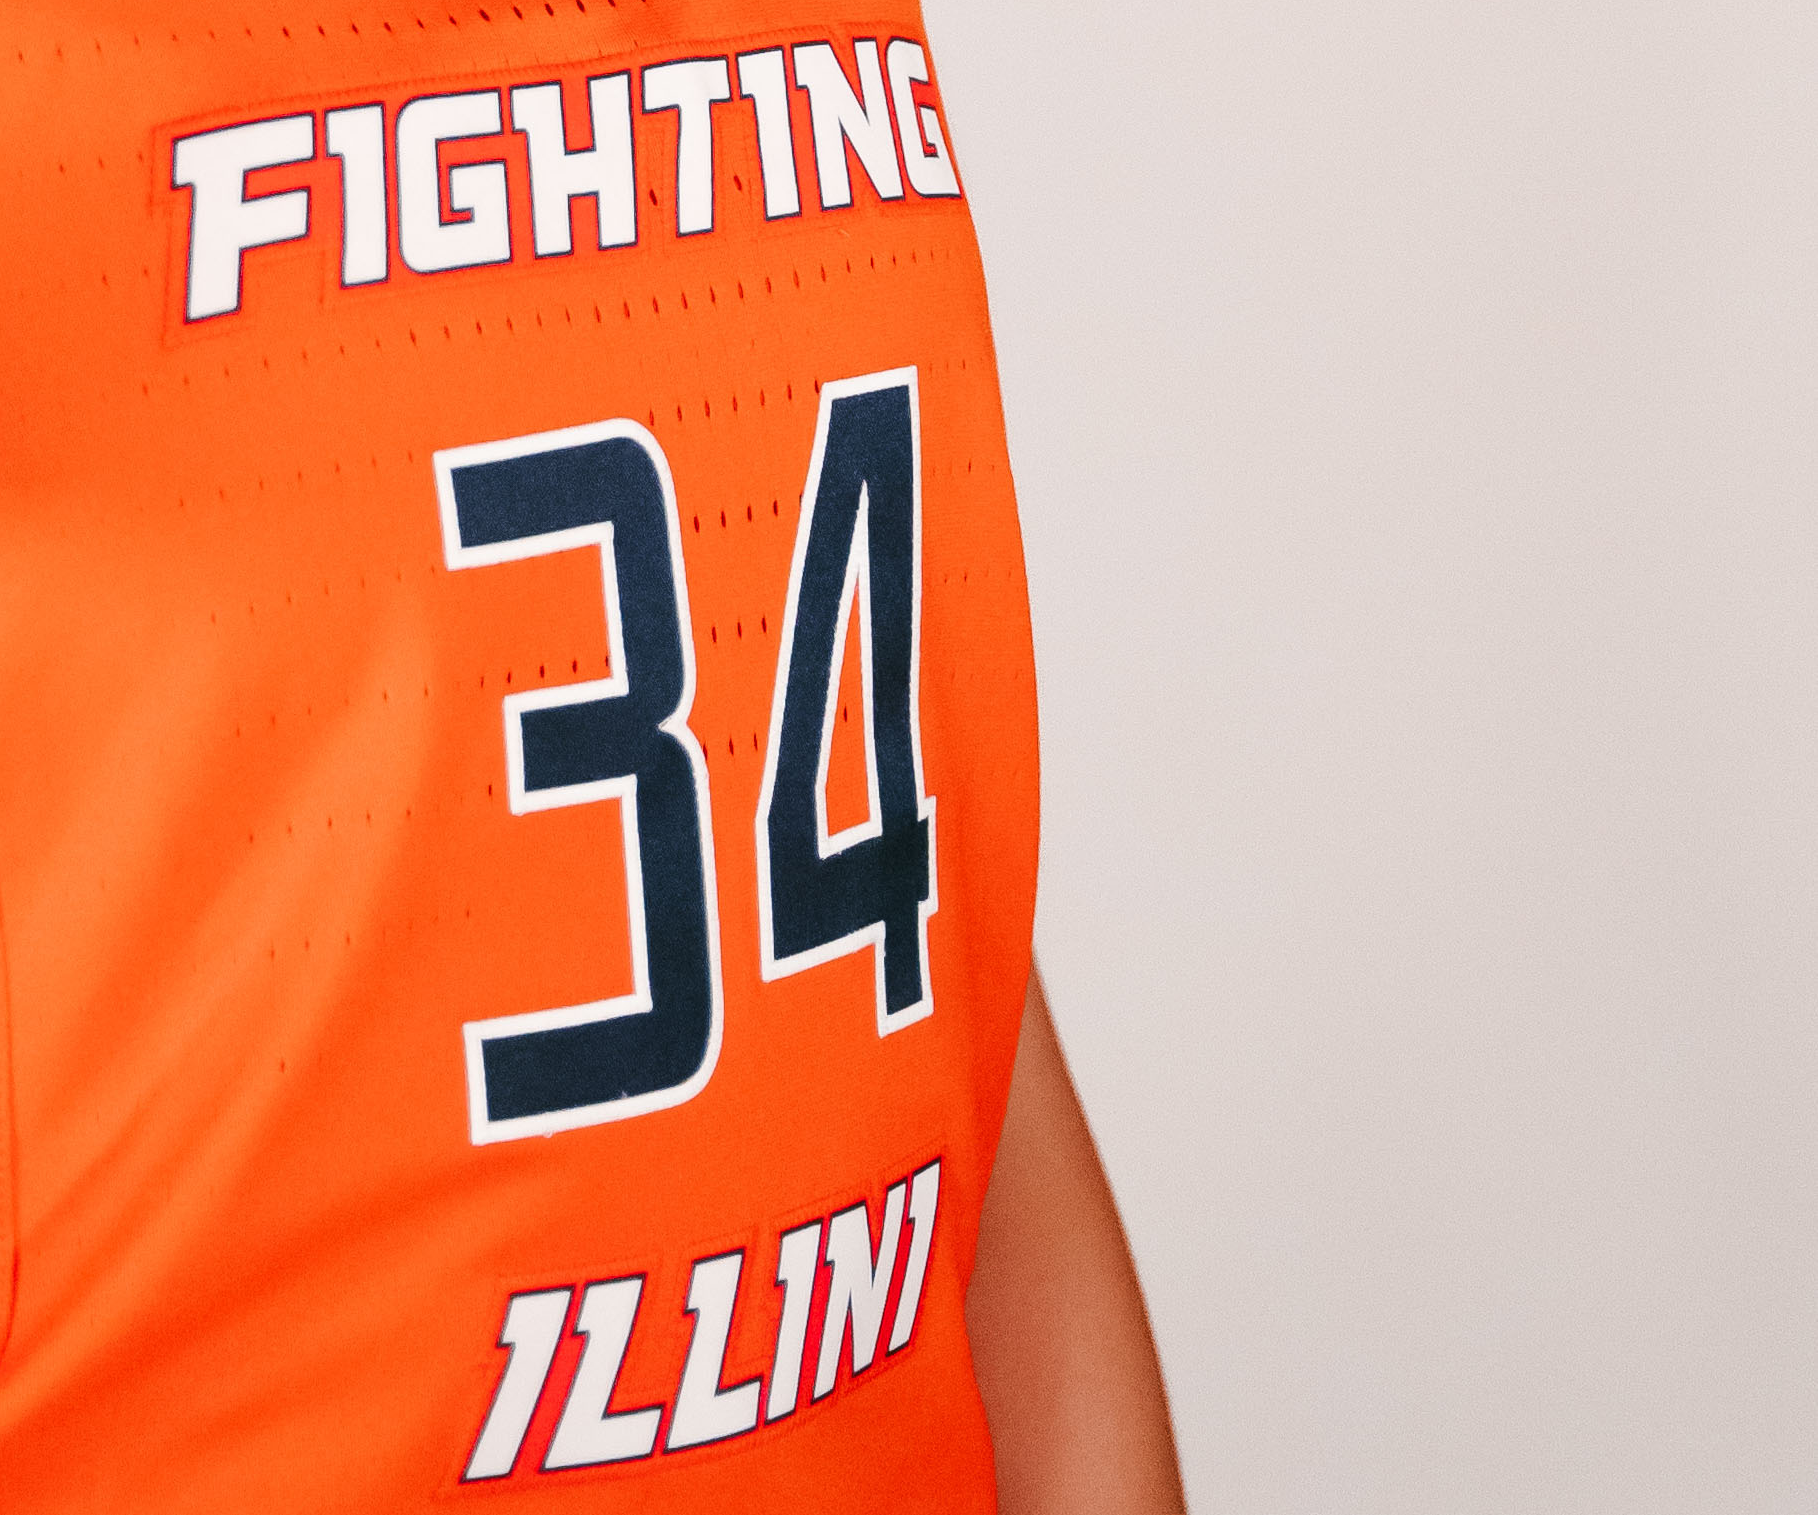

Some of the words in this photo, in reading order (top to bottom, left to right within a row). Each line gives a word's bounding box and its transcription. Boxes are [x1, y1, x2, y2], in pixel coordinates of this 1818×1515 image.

[174, 36, 962, 324] FIGHTING
[434, 365, 937, 1146] 34
[460, 1160, 943, 1484] ILLINI
